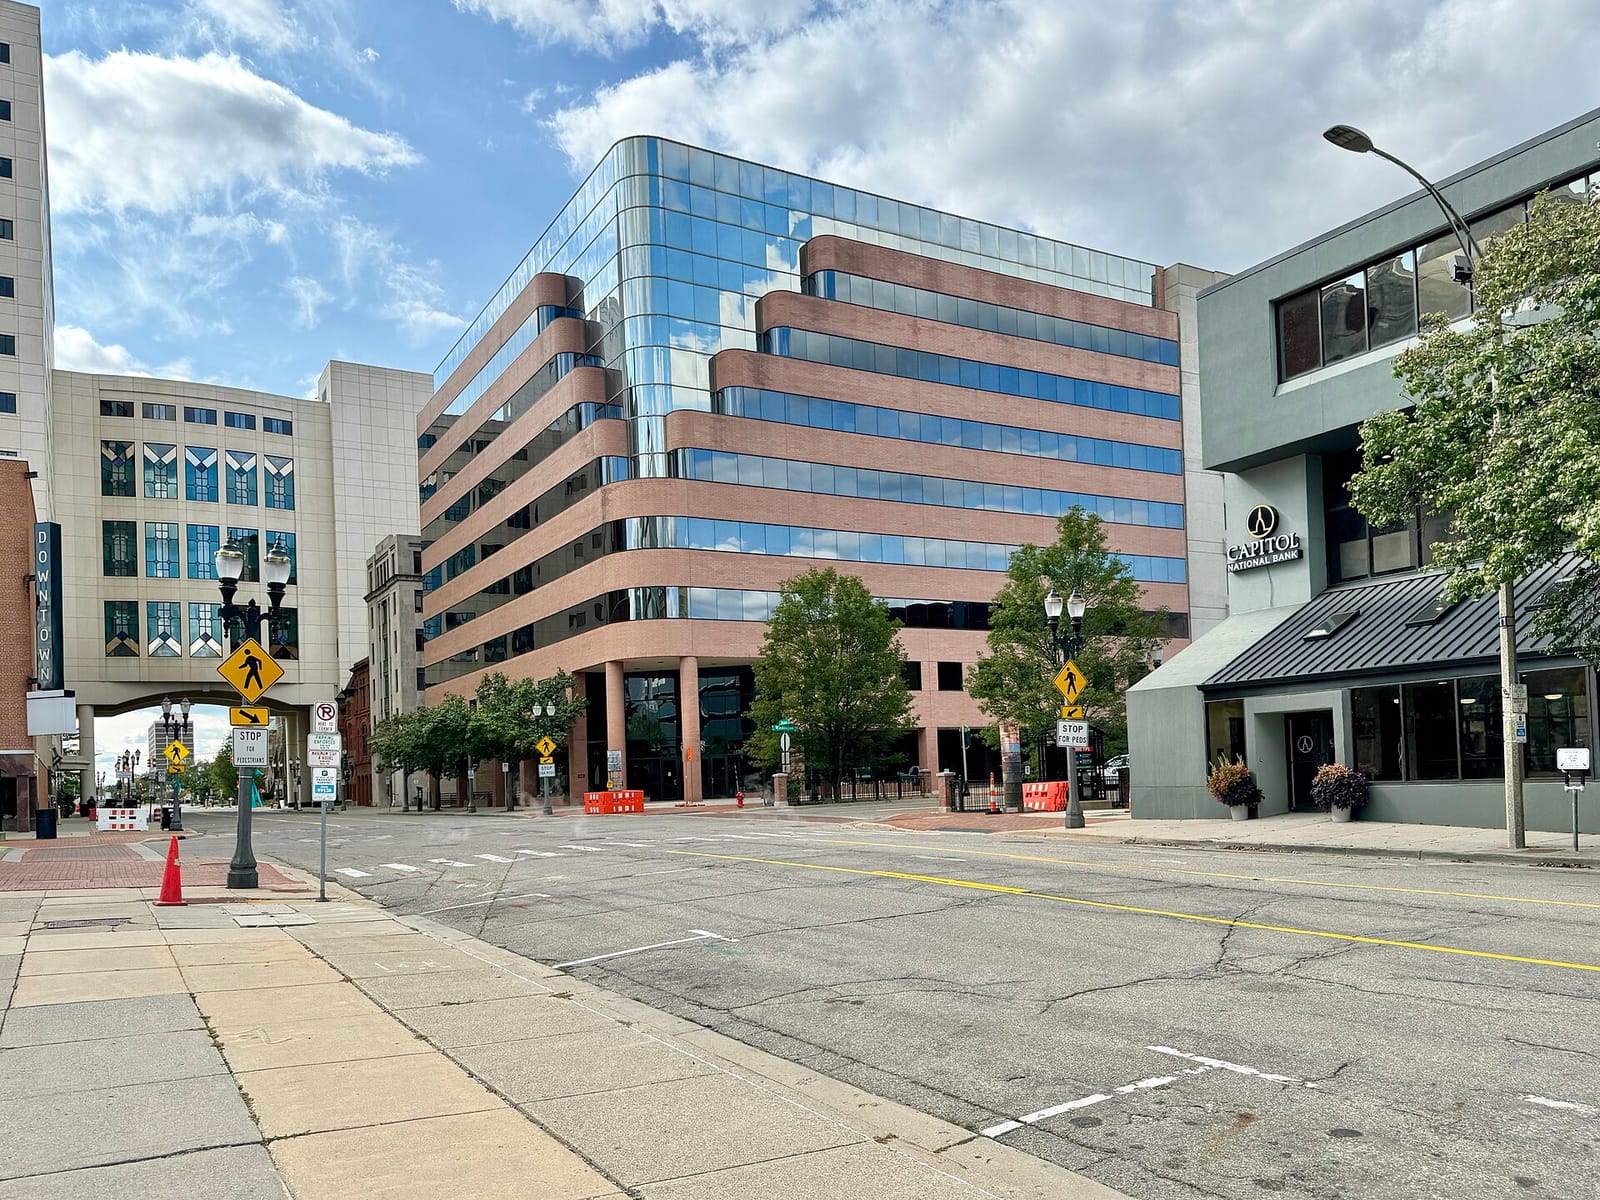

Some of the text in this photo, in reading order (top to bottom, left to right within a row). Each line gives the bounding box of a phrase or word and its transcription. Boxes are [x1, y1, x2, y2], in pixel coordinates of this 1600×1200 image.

[1226, 532, 1299, 561] CAPITOL
[1227, 550, 1299, 572] NATIONAL BANK
[37, 531, 50, 681] DOWNTOWN
[240, 731, 262, 741] STOP
[1062, 724, 1084, 733] STOP
